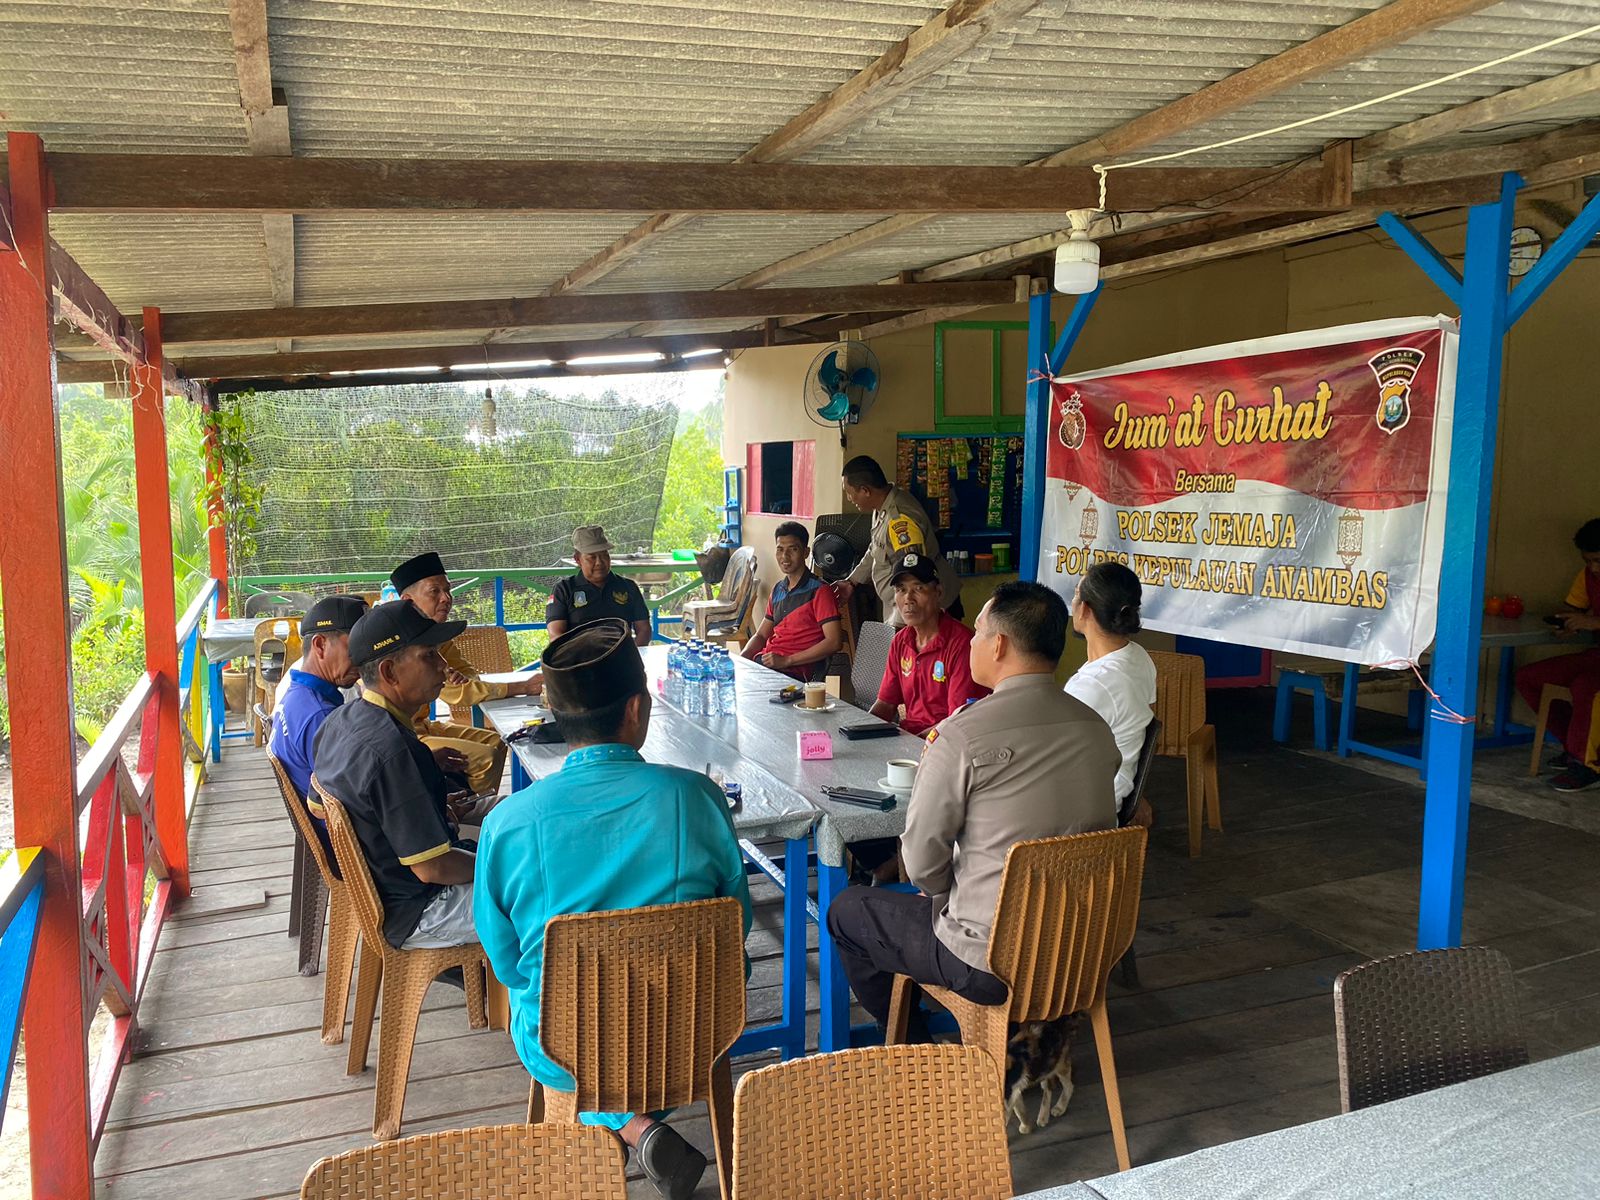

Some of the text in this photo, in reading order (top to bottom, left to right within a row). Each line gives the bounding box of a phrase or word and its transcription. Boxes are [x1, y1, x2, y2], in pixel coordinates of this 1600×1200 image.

[1213, 381, 1333, 447] Curhat
[1174, 469, 1236, 493] Bersama
[1117, 511, 1297, 549] POLSEK JEMAJA
[1133, 553, 1256, 595] KEPULAUAN
[1260, 564, 1388, 610] ANAMBAS
